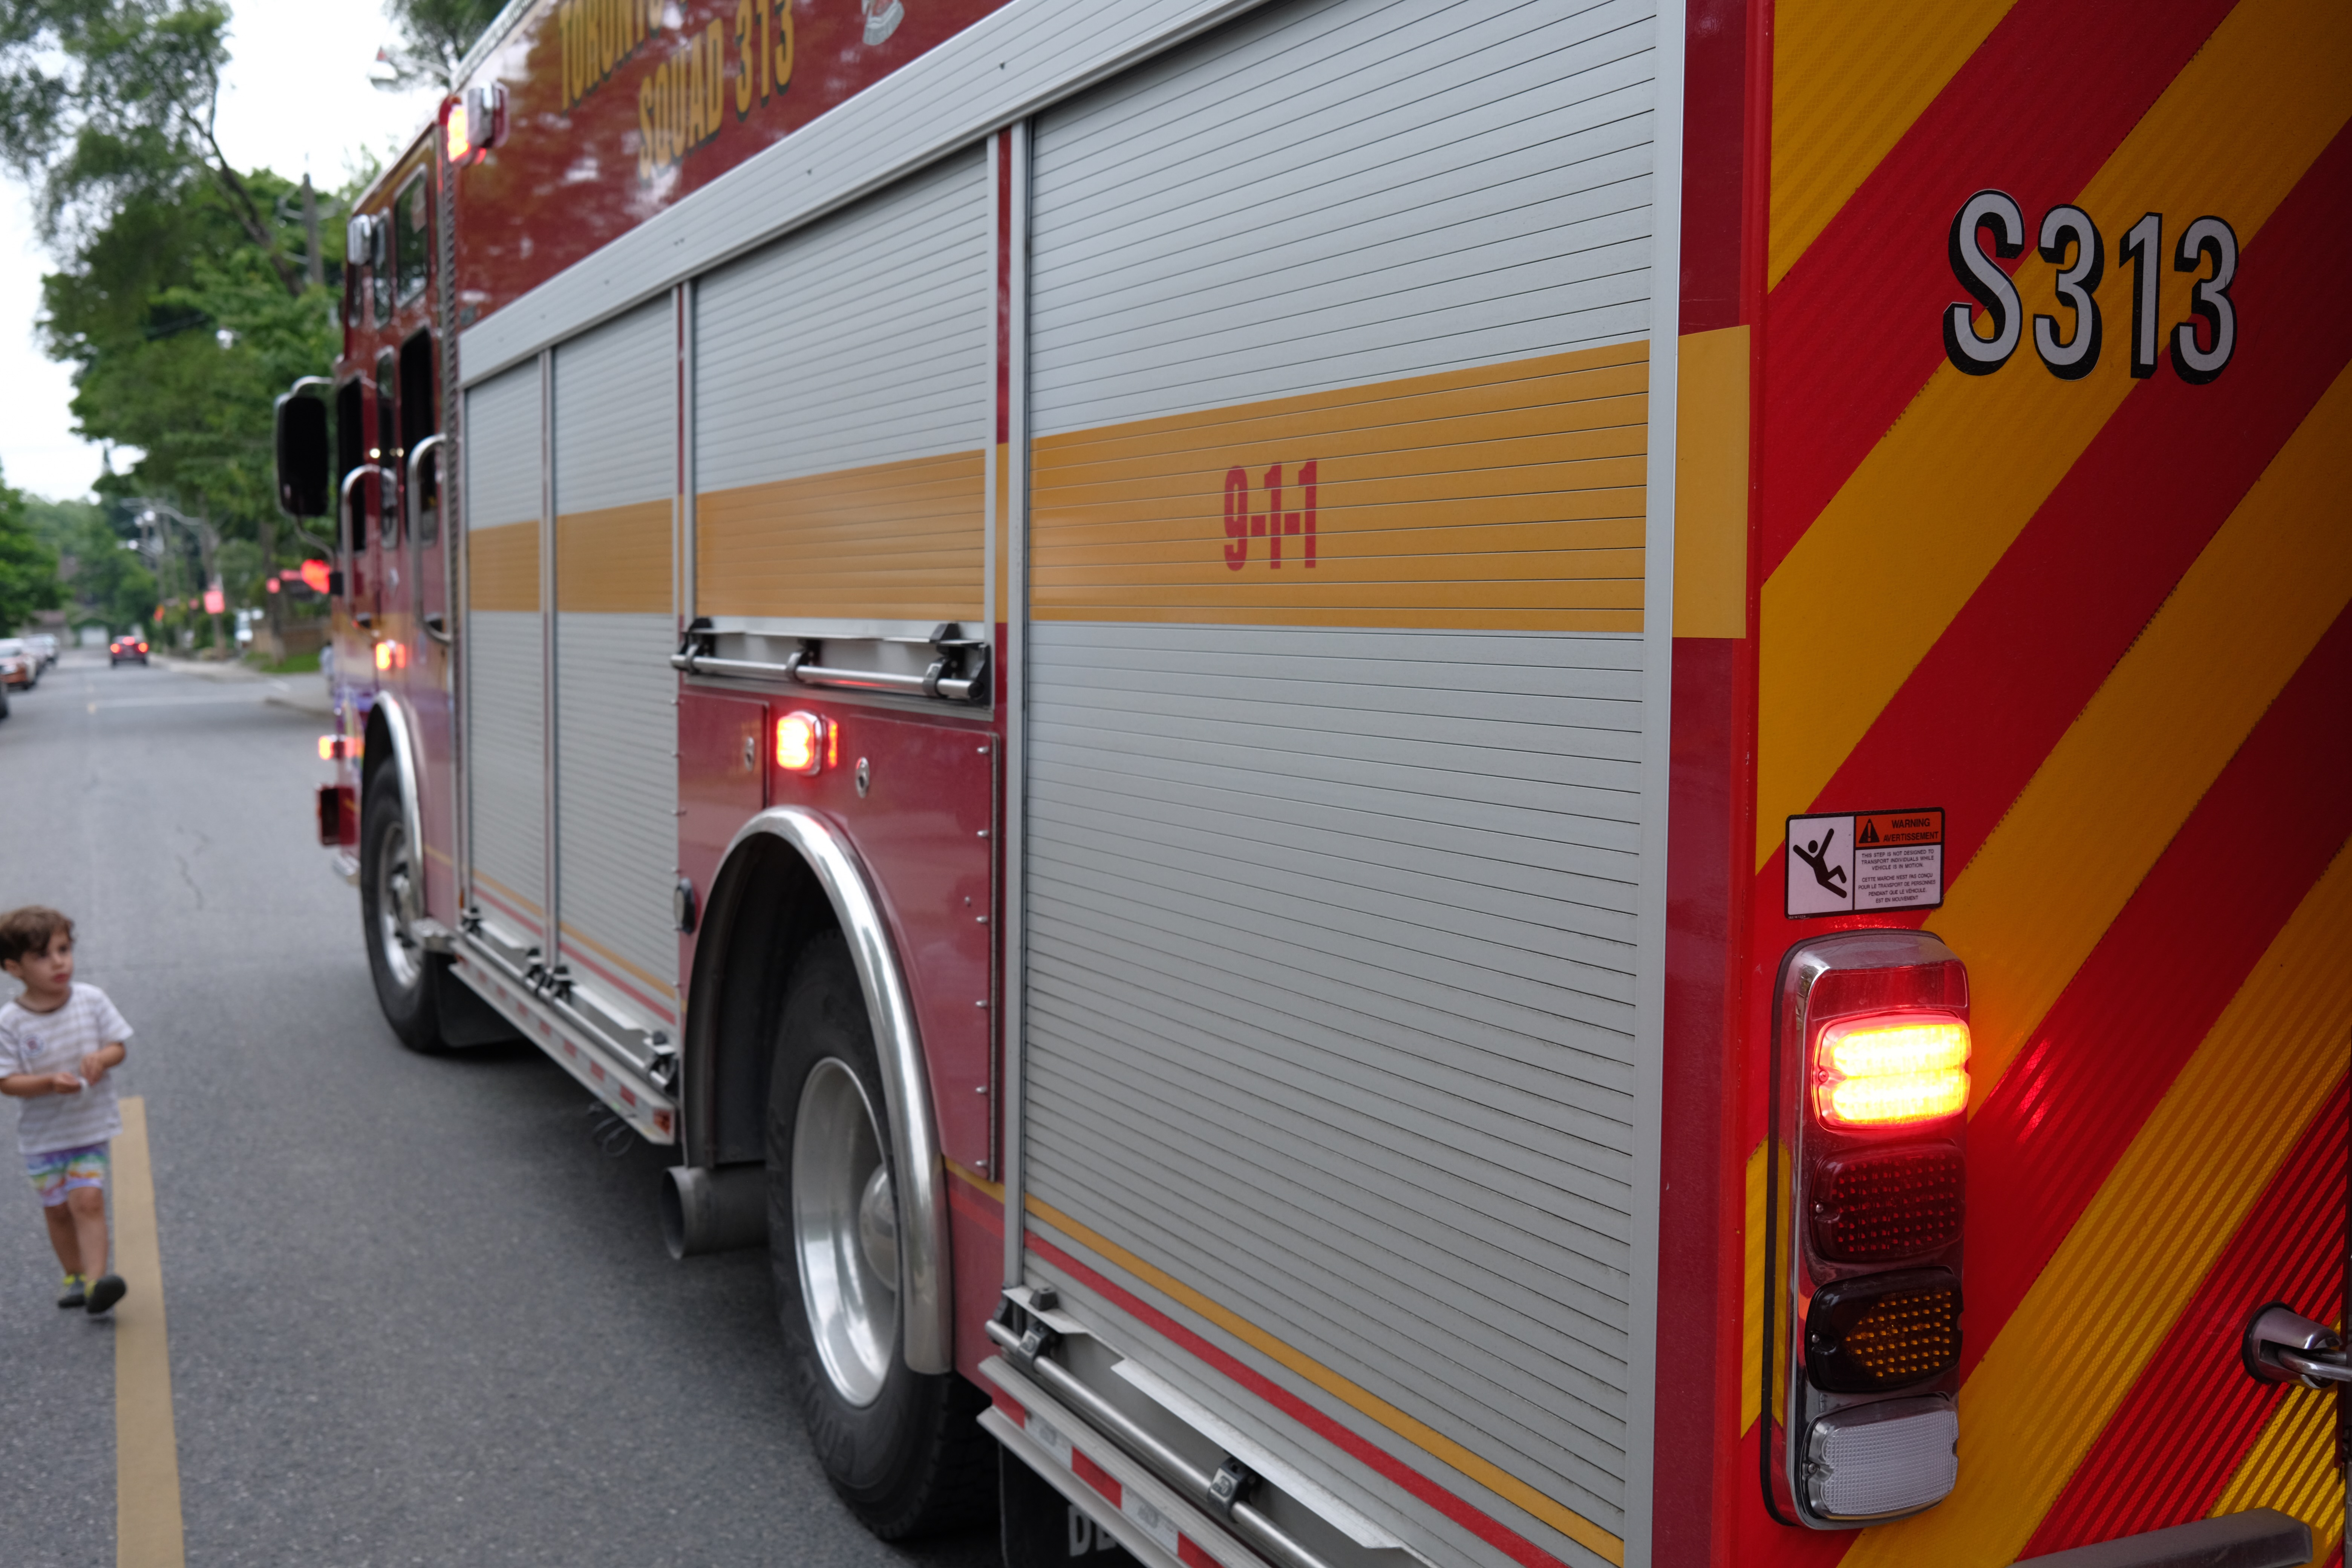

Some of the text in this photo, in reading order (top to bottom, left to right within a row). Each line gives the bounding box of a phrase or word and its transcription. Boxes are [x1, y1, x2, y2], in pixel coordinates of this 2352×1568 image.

[639, 0, 795, 181] SQUAD 313
[1943, 188, 2239, 385] S313
[1883, 831, 1939, 842] AVERTISSEMENT
[1891, 818, 1930, 828] WARNING
